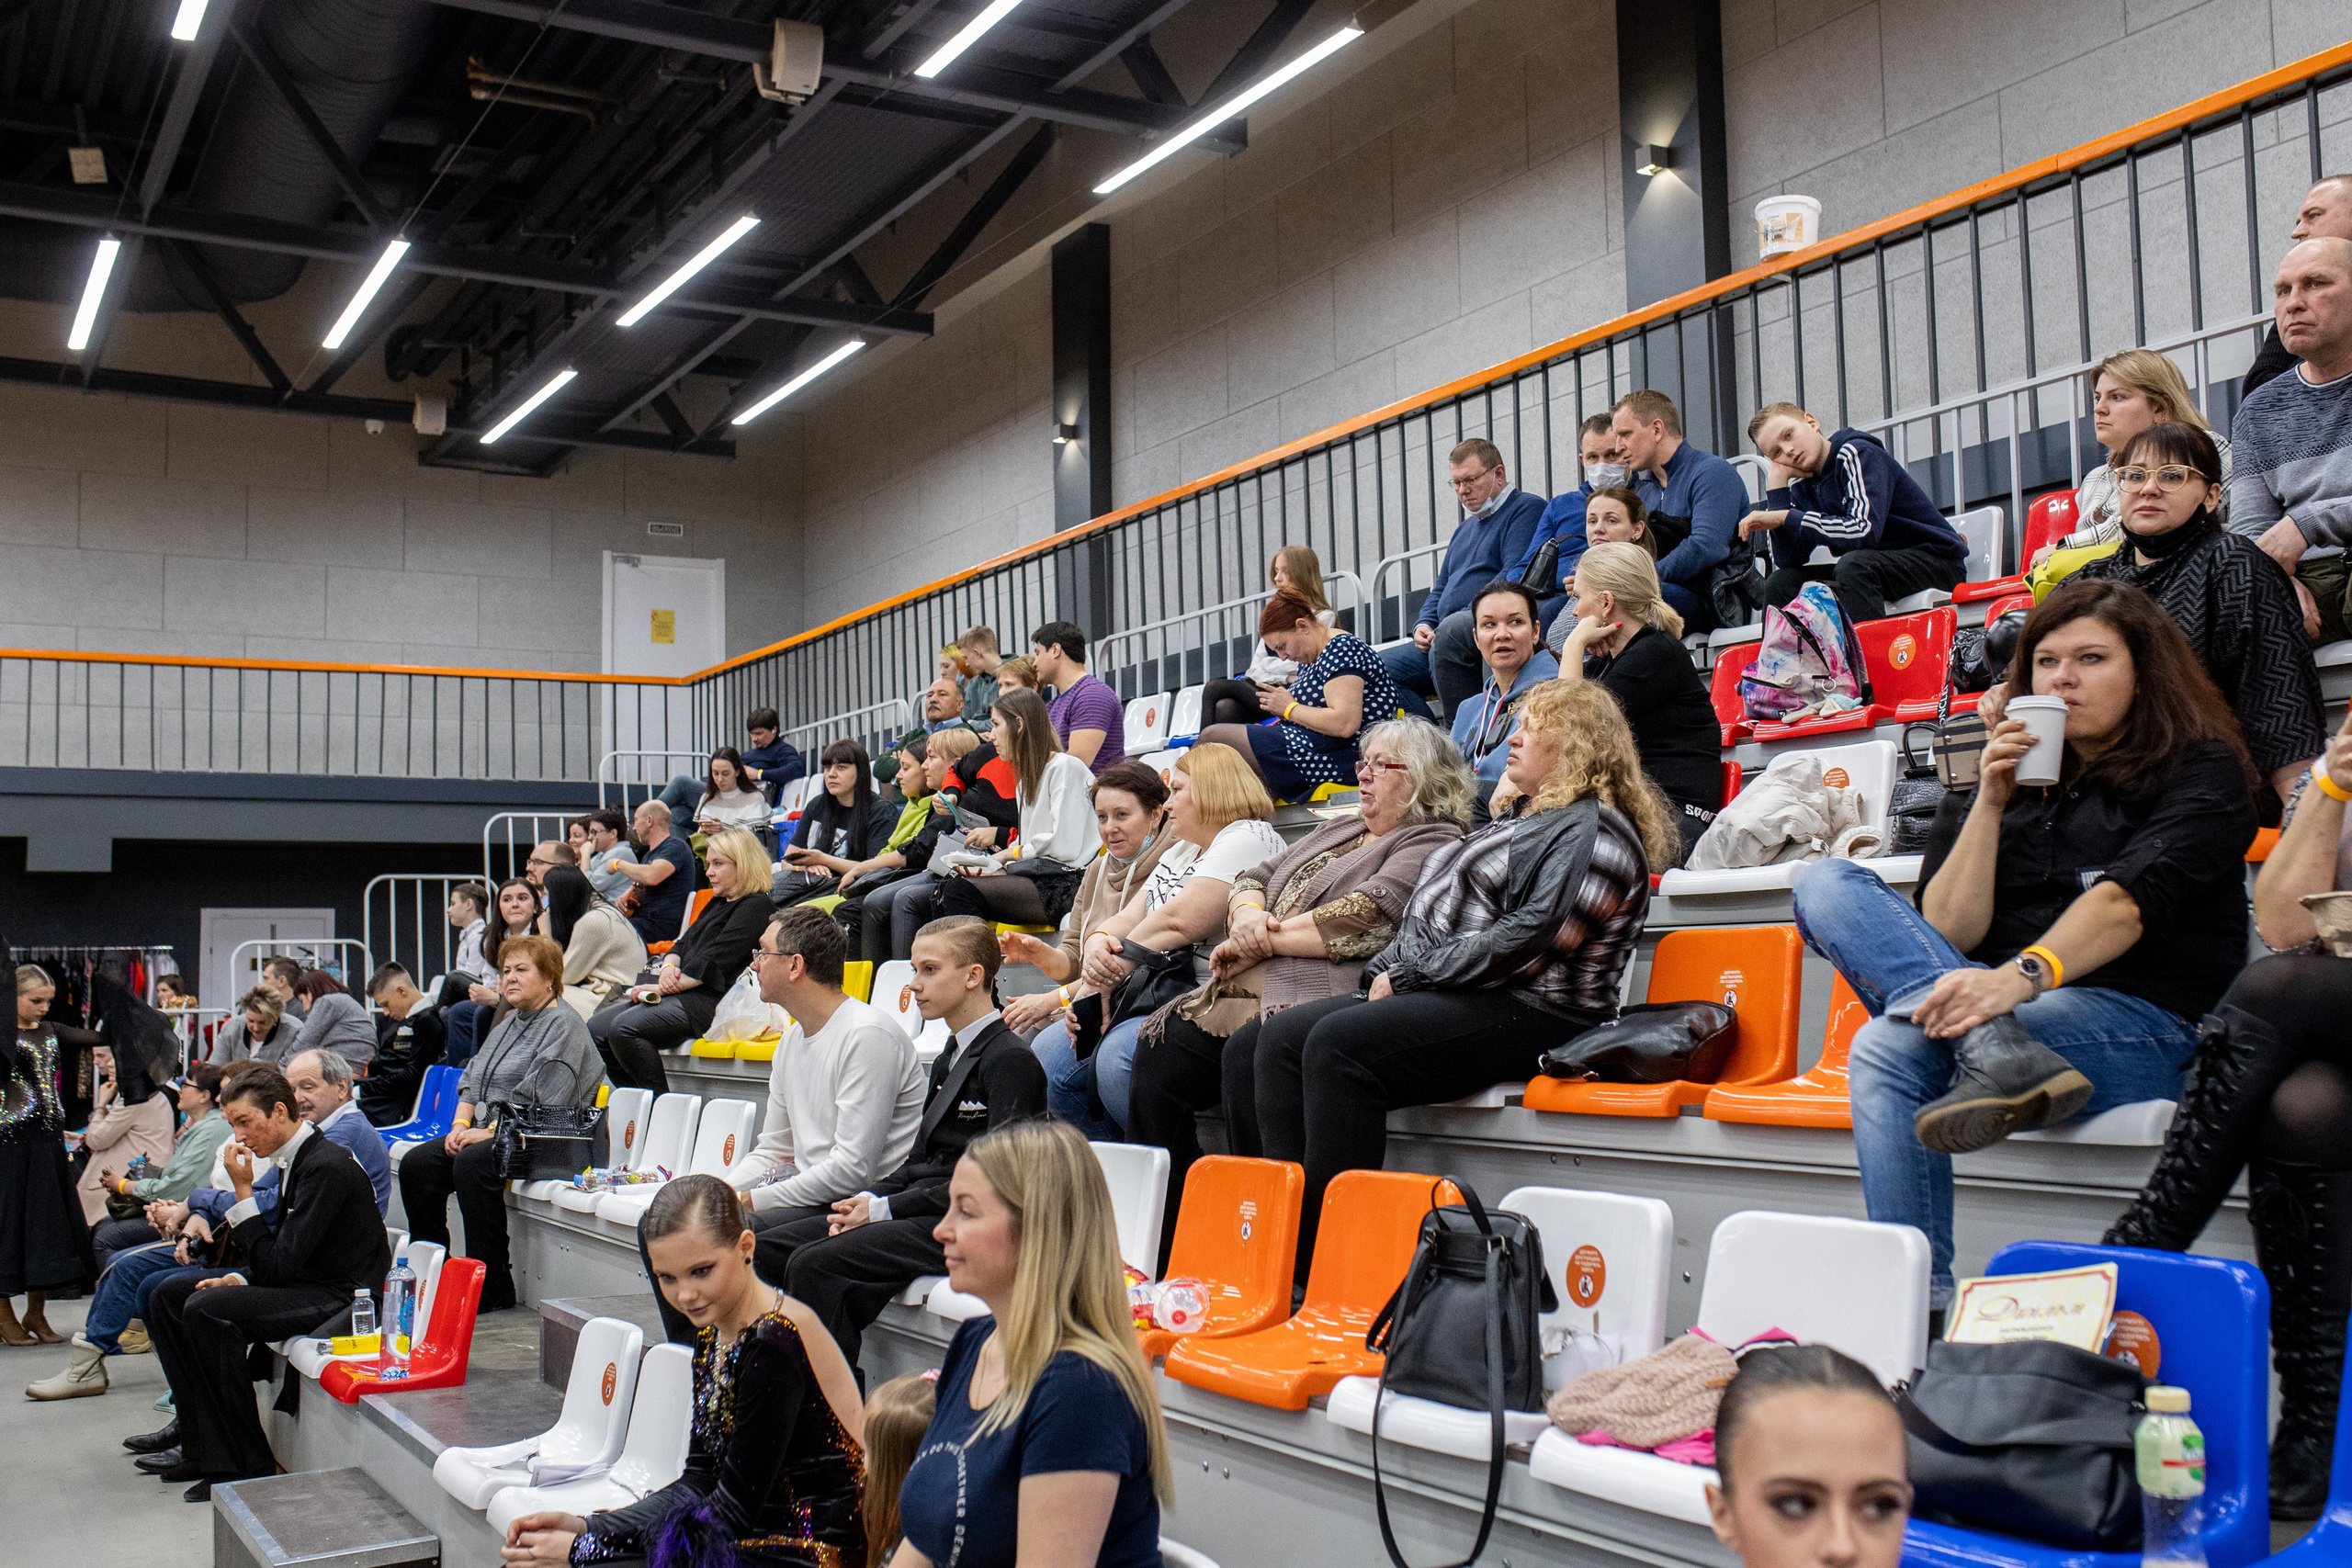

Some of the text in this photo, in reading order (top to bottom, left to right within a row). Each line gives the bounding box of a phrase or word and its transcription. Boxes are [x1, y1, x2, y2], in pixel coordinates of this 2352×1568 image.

[1938, 683, 1949, 728] ONCLE
[1685, 804, 1717, 823] SPOR
[929, 1442, 944, 1455] DO
